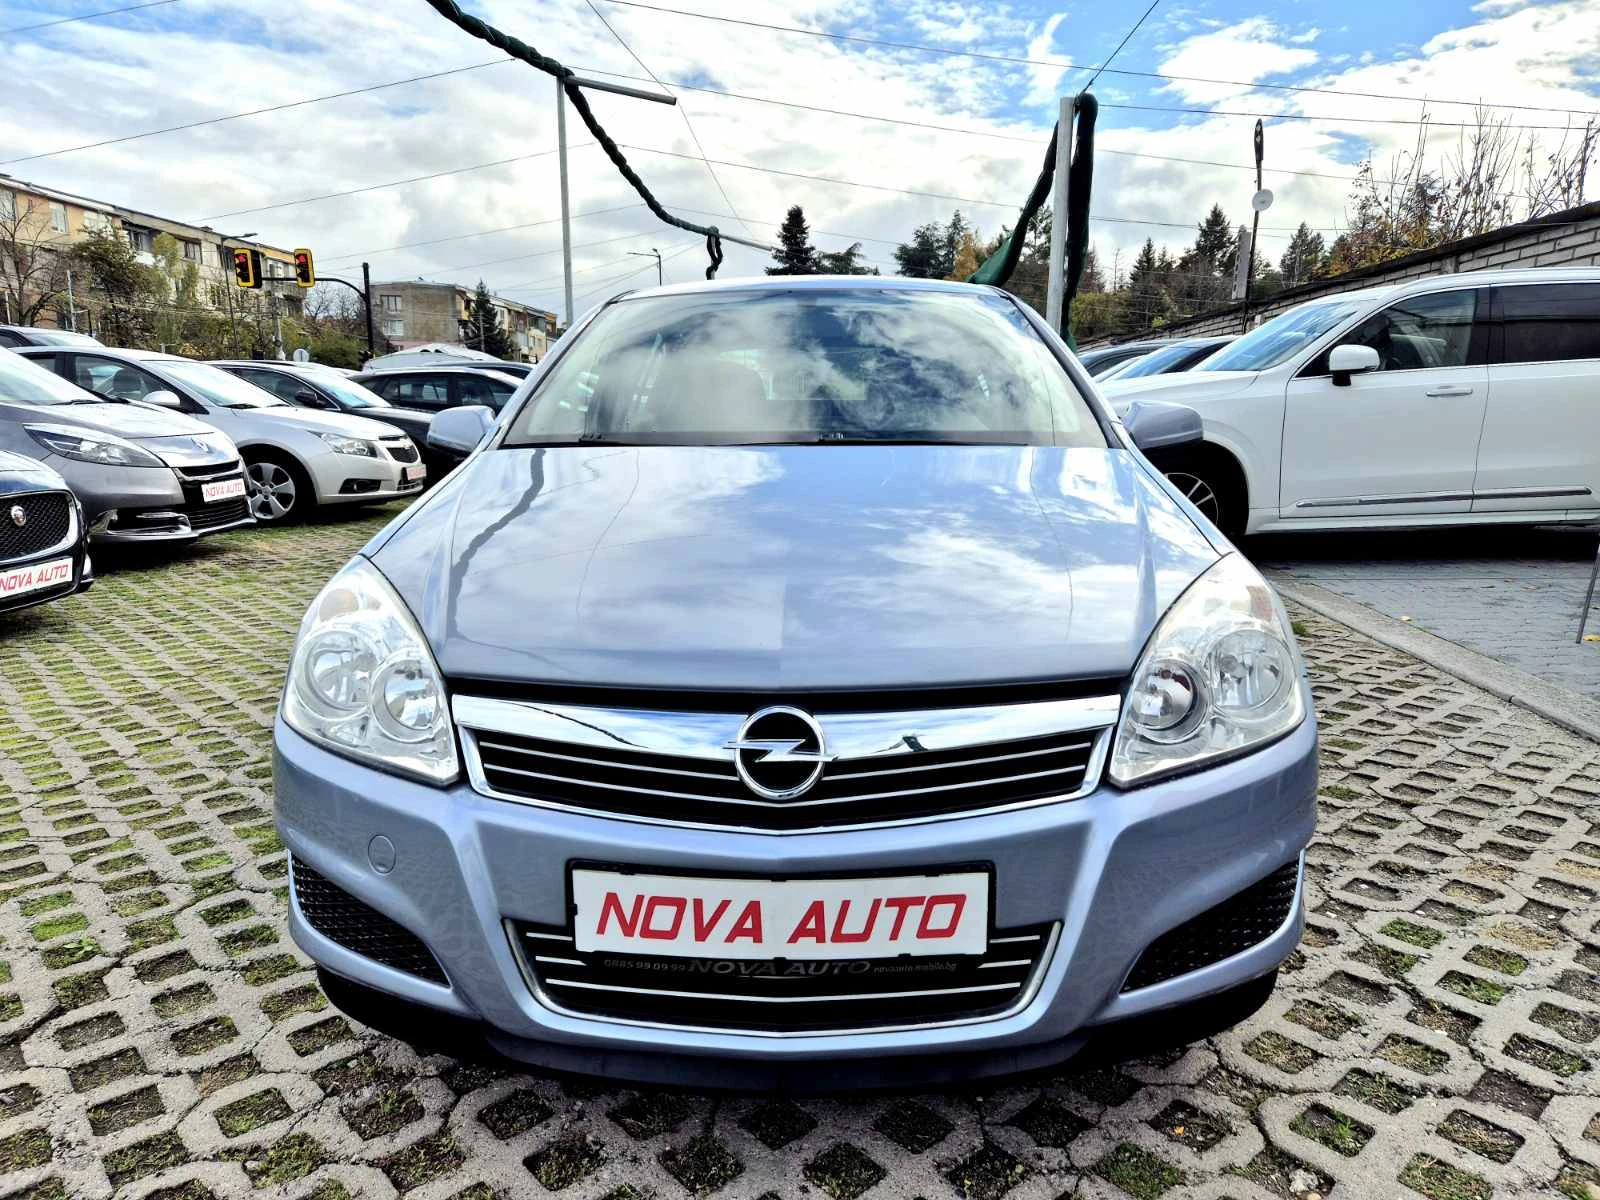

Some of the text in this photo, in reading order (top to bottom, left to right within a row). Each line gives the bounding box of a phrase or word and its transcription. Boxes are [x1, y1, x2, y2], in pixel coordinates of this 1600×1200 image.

[0, 564, 69, 591] NOVA AUTO
[596, 892, 967, 944] NOVA AUTO
[688, 959, 776, 975] NOVA
[784, 960, 871, 975] AUTO
